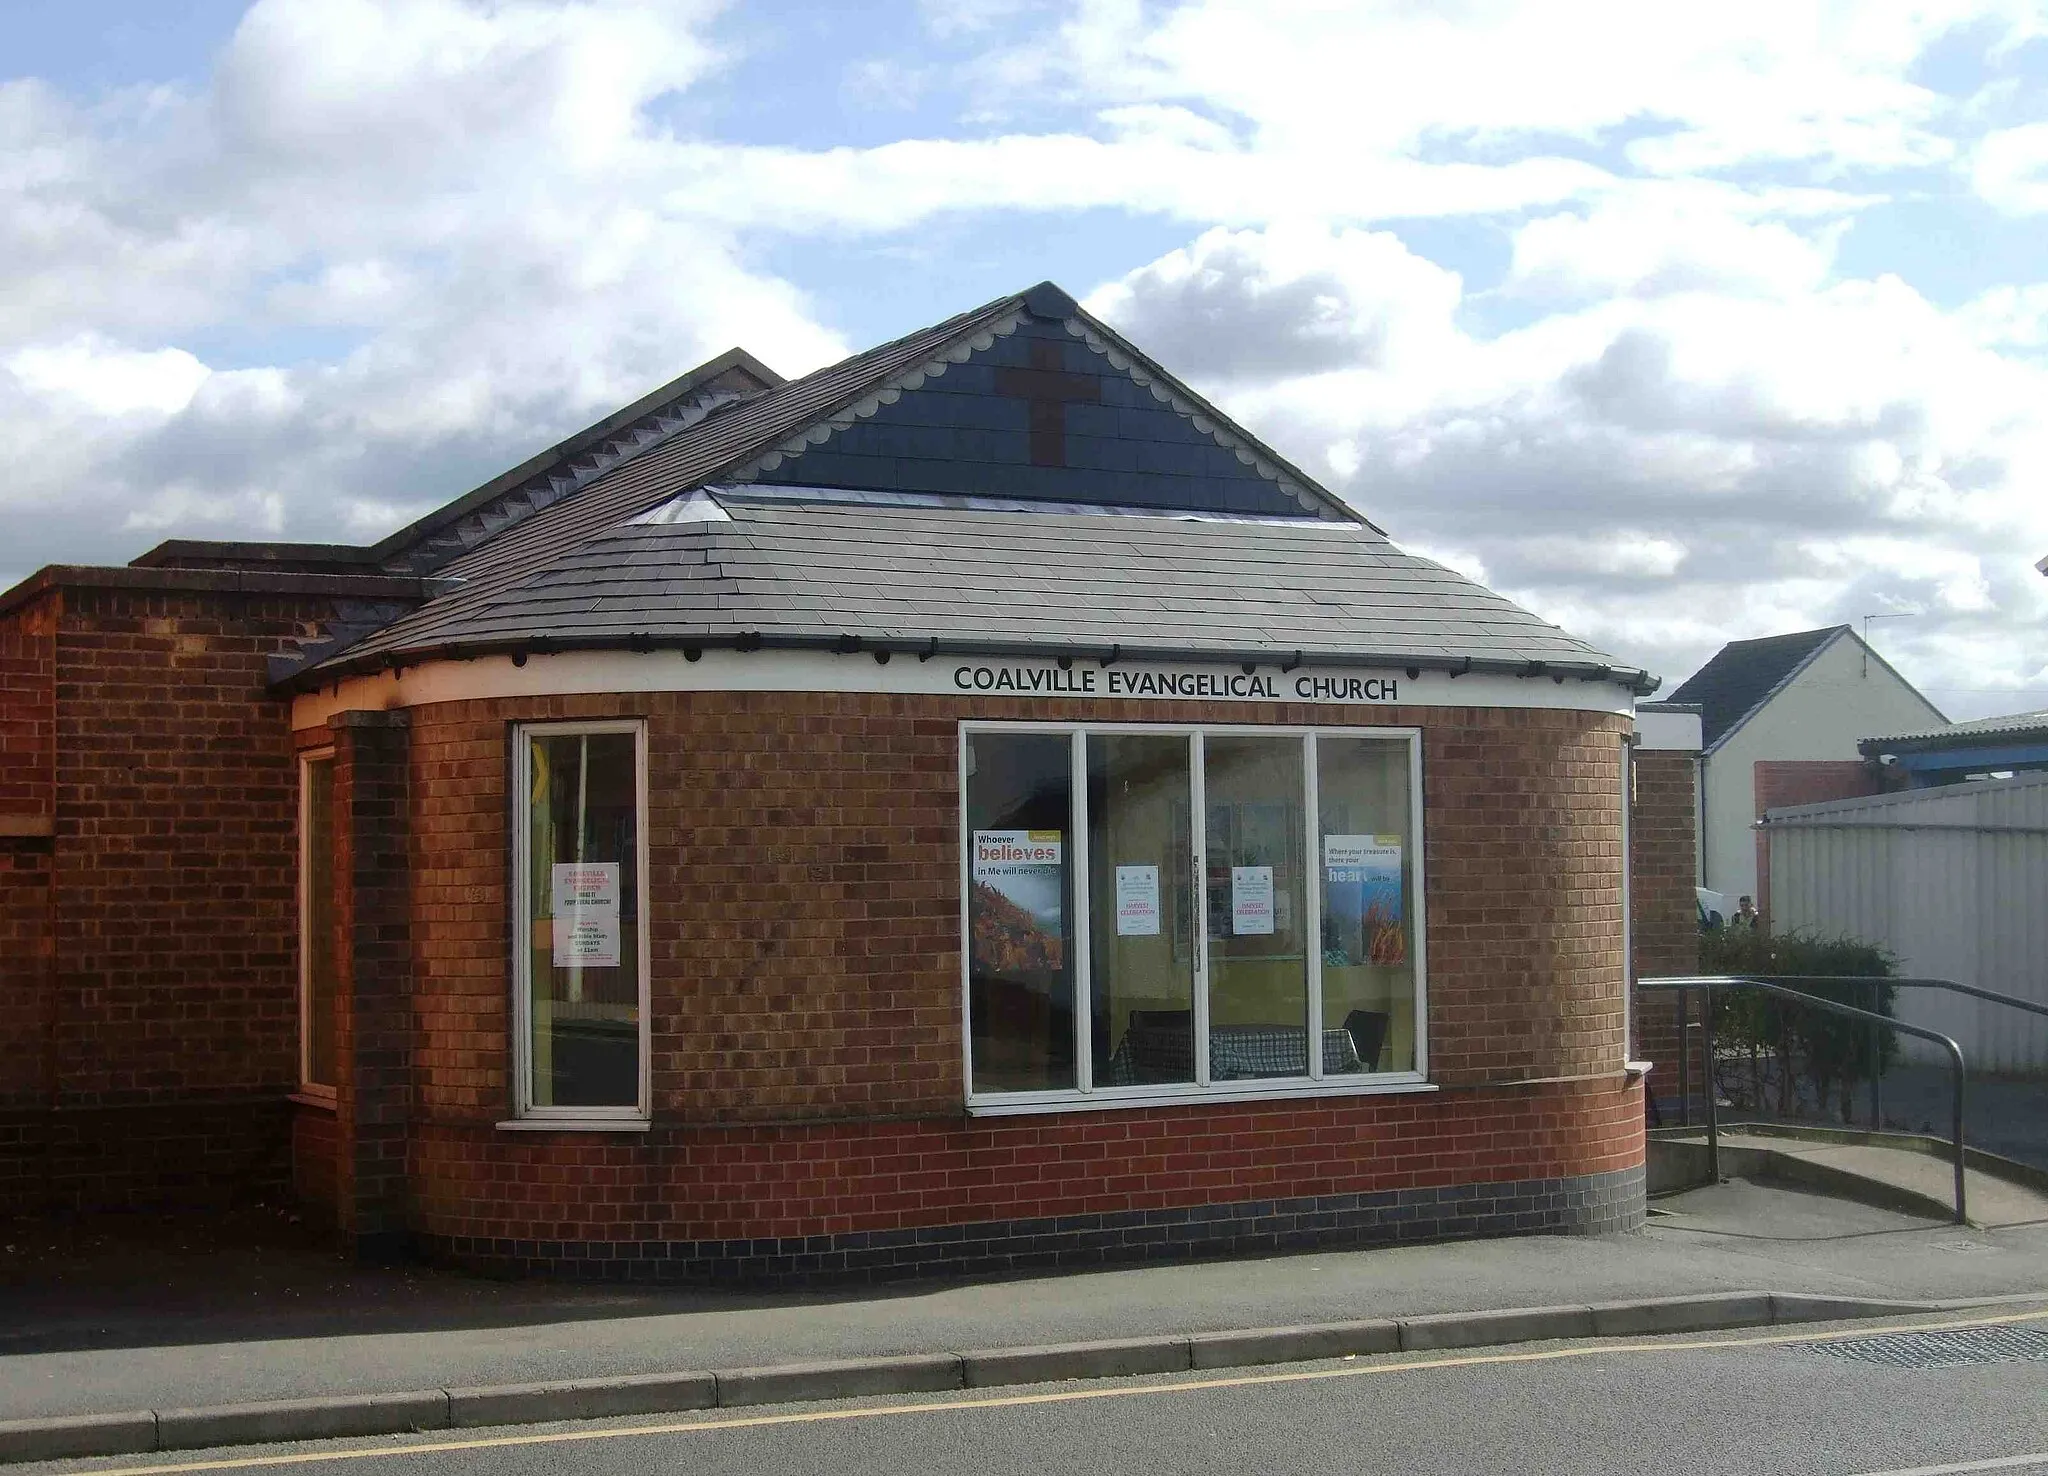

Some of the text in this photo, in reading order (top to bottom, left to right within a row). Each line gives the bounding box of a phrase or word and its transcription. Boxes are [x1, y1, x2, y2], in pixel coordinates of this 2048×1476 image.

[953, 667, 1398, 701] COALVILLE EVANGELICAL CHURCH
[978, 835, 1014, 844] Whoever
[978, 844, 1056, 861] believes
[977, 867, 986, 875] in
[988, 867, 1001, 875] Me
[1002, 867, 1017, 875] will
[1018, 867, 1040, 875] never
[1328, 867, 1368, 882] heart
